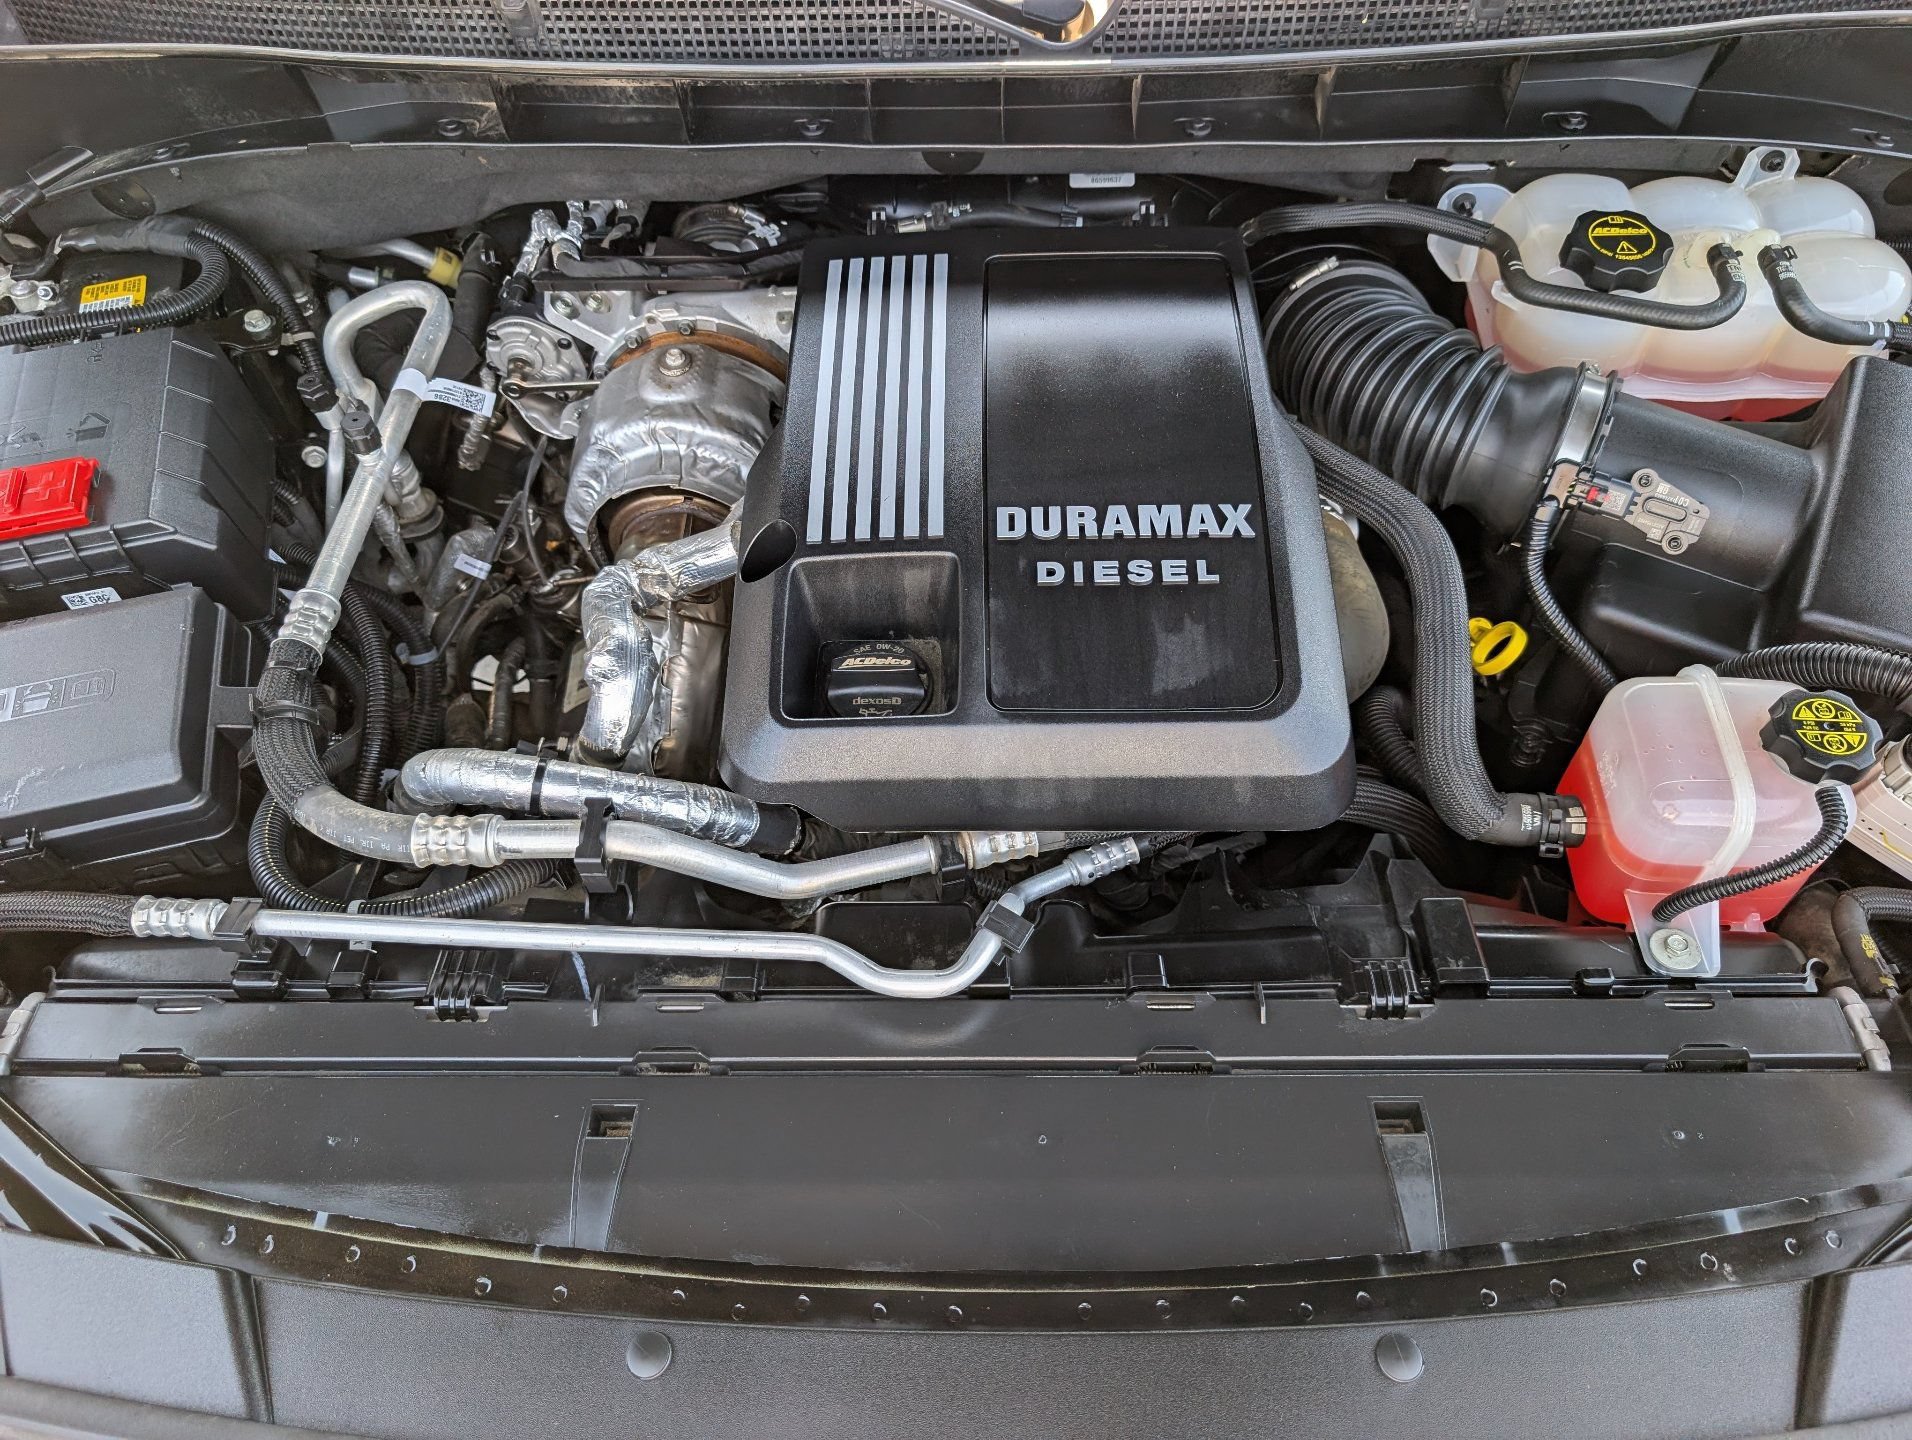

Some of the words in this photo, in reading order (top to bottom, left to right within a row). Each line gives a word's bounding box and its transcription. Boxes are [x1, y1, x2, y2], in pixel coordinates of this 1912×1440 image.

[1592, 227, 1648, 236] ACDelco
[996, 503, 1256, 540] DURAMAX
[1036, 559, 1220, 586] DIESEL
[853, 644, 872, 655] SAE
[876, 643, 905, 654] 0W-20
[840, 656, 912, 668] ACDelco
